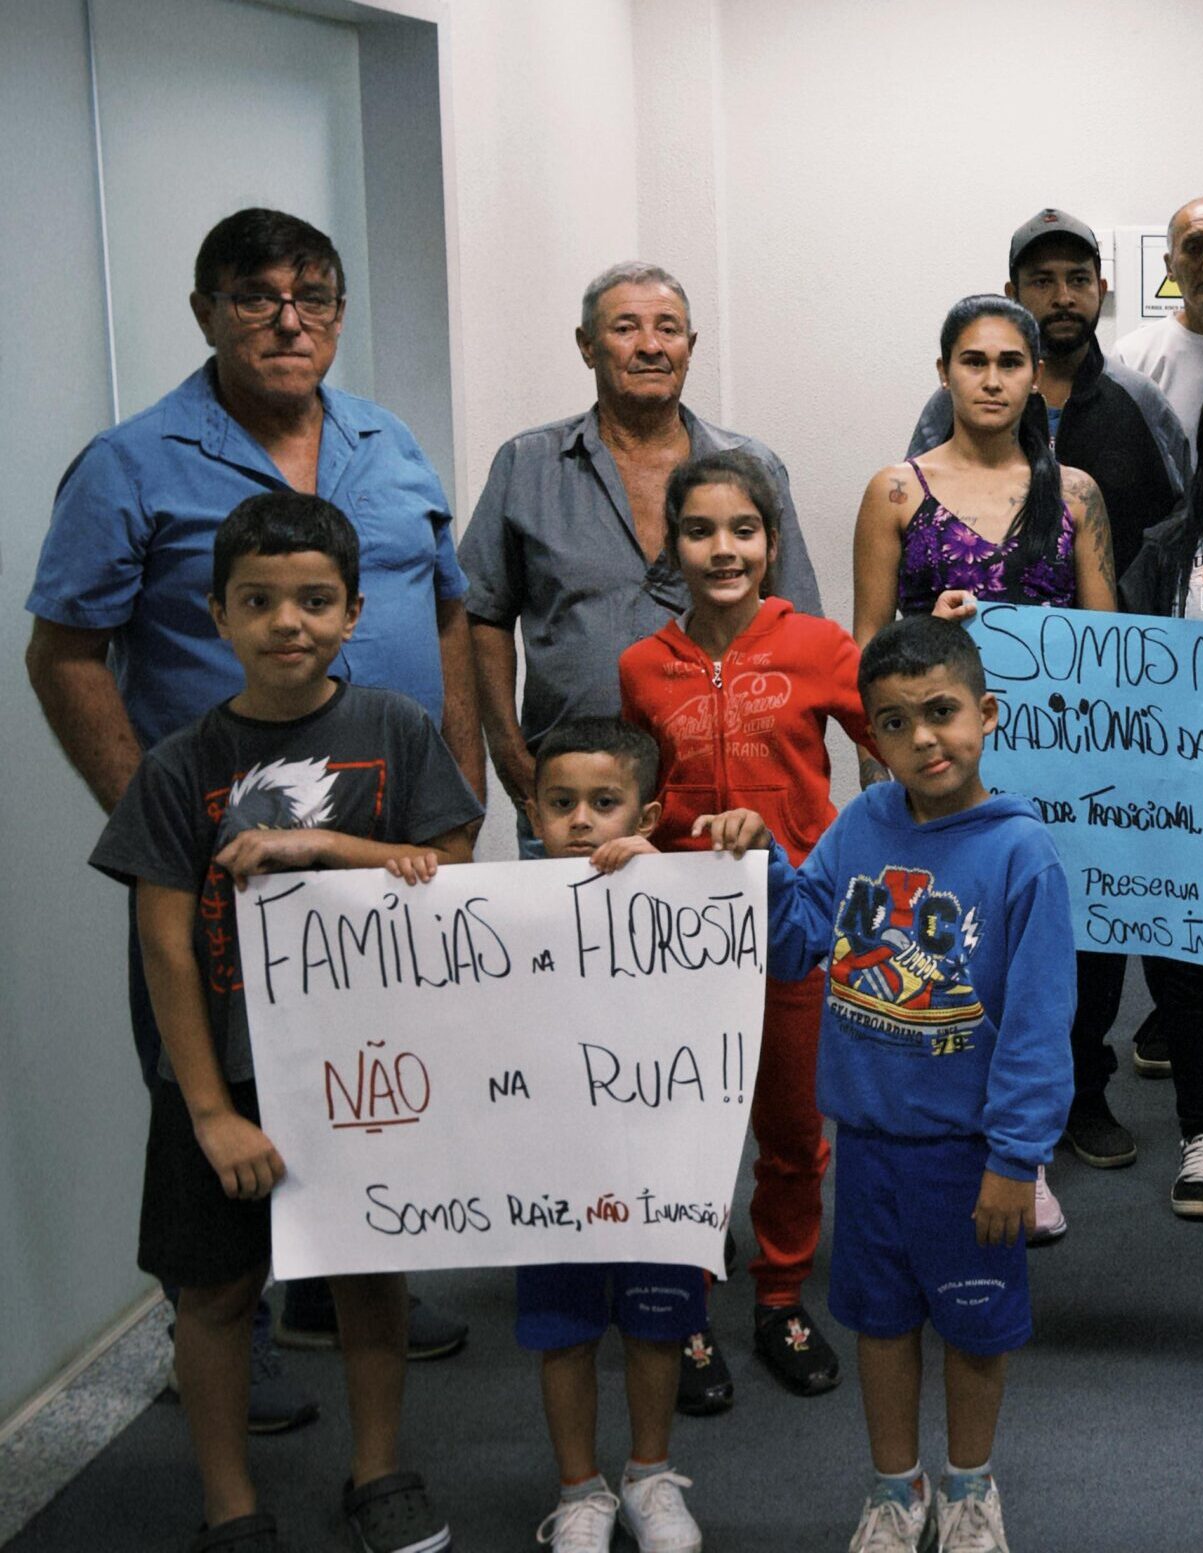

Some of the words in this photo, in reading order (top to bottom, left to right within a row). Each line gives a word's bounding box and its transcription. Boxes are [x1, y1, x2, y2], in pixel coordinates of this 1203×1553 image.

[980, 604, 1179, 687] SOMOS
[1079, 785, 1202, 834] TRADICIONAL
[1086, 904, 1174, 946] SOMOS
[532, 956, 555, 974] NA
[323, 1039, 431, 1120] NÃO
[488, 1070, 531, 1101] NA
[365, 1184, 492, 1236] SOMOS
[585, 1192, 630, 1224] NÃO
